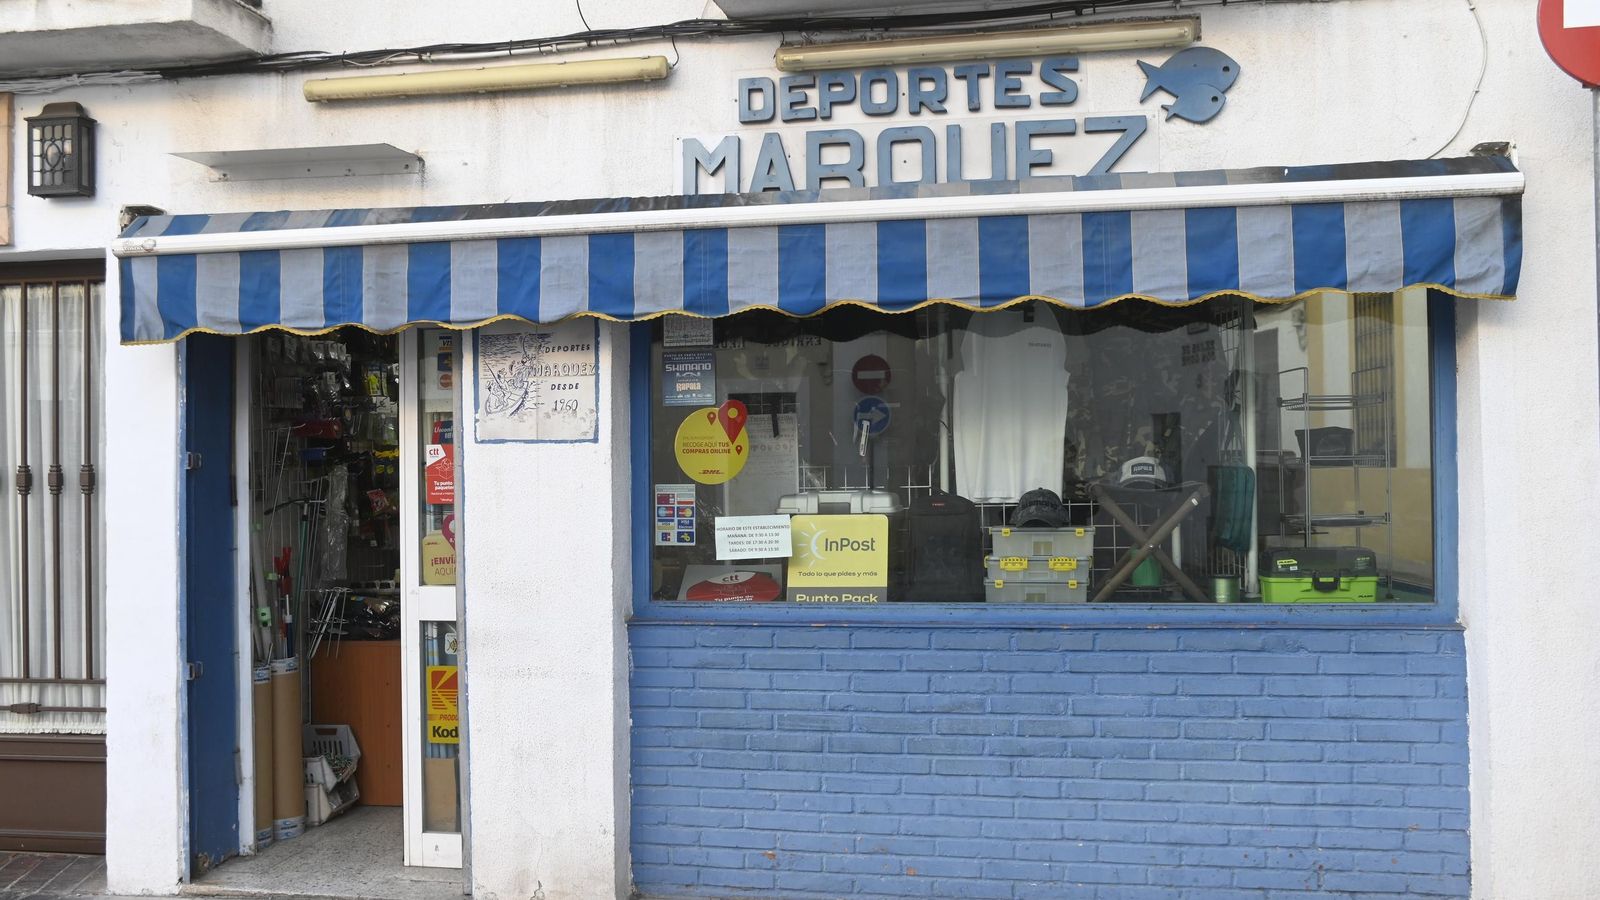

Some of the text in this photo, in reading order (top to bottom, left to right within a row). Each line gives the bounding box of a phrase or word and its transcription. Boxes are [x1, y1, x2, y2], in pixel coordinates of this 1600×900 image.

[738, 56, 1079, 124] DEPORTES
[681, 114, 1149, 195] MARQUEZ
[545, 343, 590, 353] DEPORTES
[531, 362, 596, 377] MARQUEZ
[665, 363, 712, 372] SHIMANO
[551, 382, 580, 391] DESDE
[553, 398, 579, 412] 1960
[429, 447, 440, 456] ctt
[824, 537, 876, 552] InPost
[722, 574, 740, 583] ctt
[839, 570, 856, 578] pides
[796, 594, 879, 602] Punto Pack
